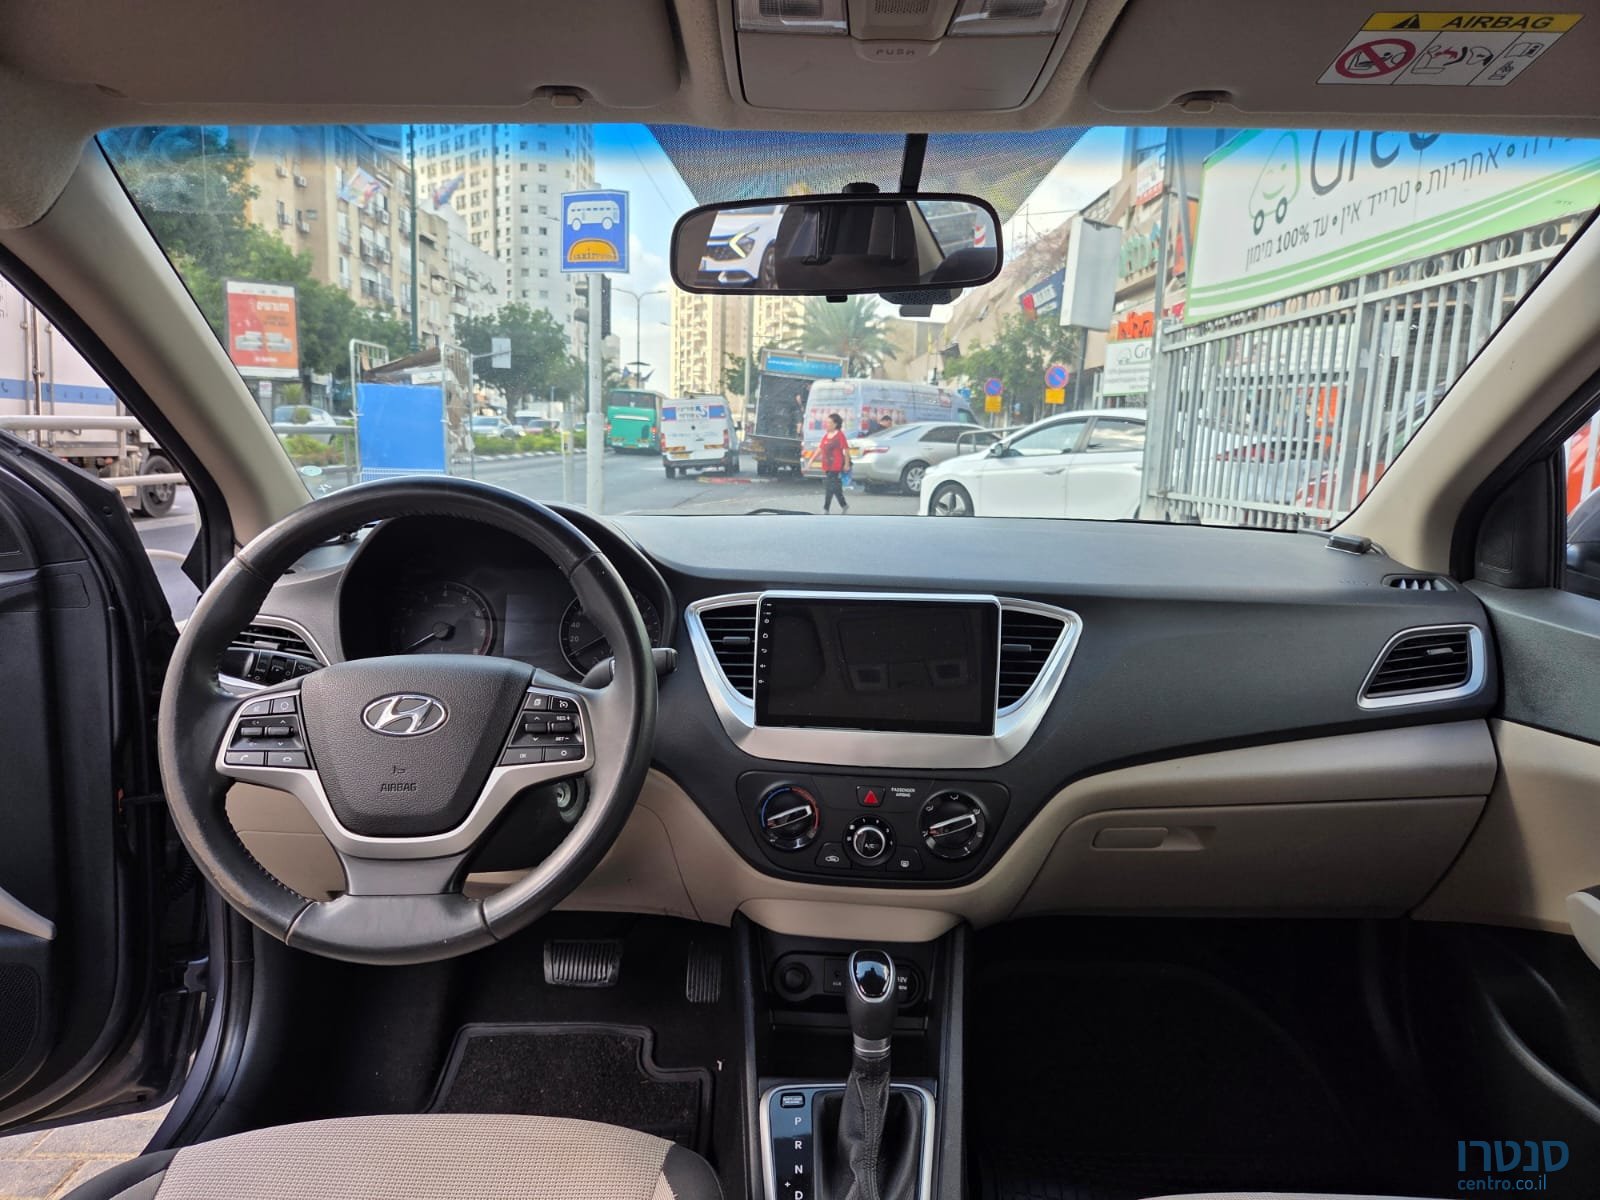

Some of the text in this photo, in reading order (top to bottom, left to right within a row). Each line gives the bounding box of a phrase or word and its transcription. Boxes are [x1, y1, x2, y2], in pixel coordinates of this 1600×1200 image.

[1442, 16, 1555, 29] AIRBAG
[1340, 199, 1363, 236] אין
[1313, 213, 1330, 239] עד
[1276, 221, 1310, 252] 100%
[1245, 235, 1272, 272] מימון
[380, 783, 417, 792] AIRBAG
[794, 1117, 802, 1126] P
[794, 1140, 803, 1150] R
[794, 1164, 803, 1174] N
[794, 1190, 803, 1200] D
